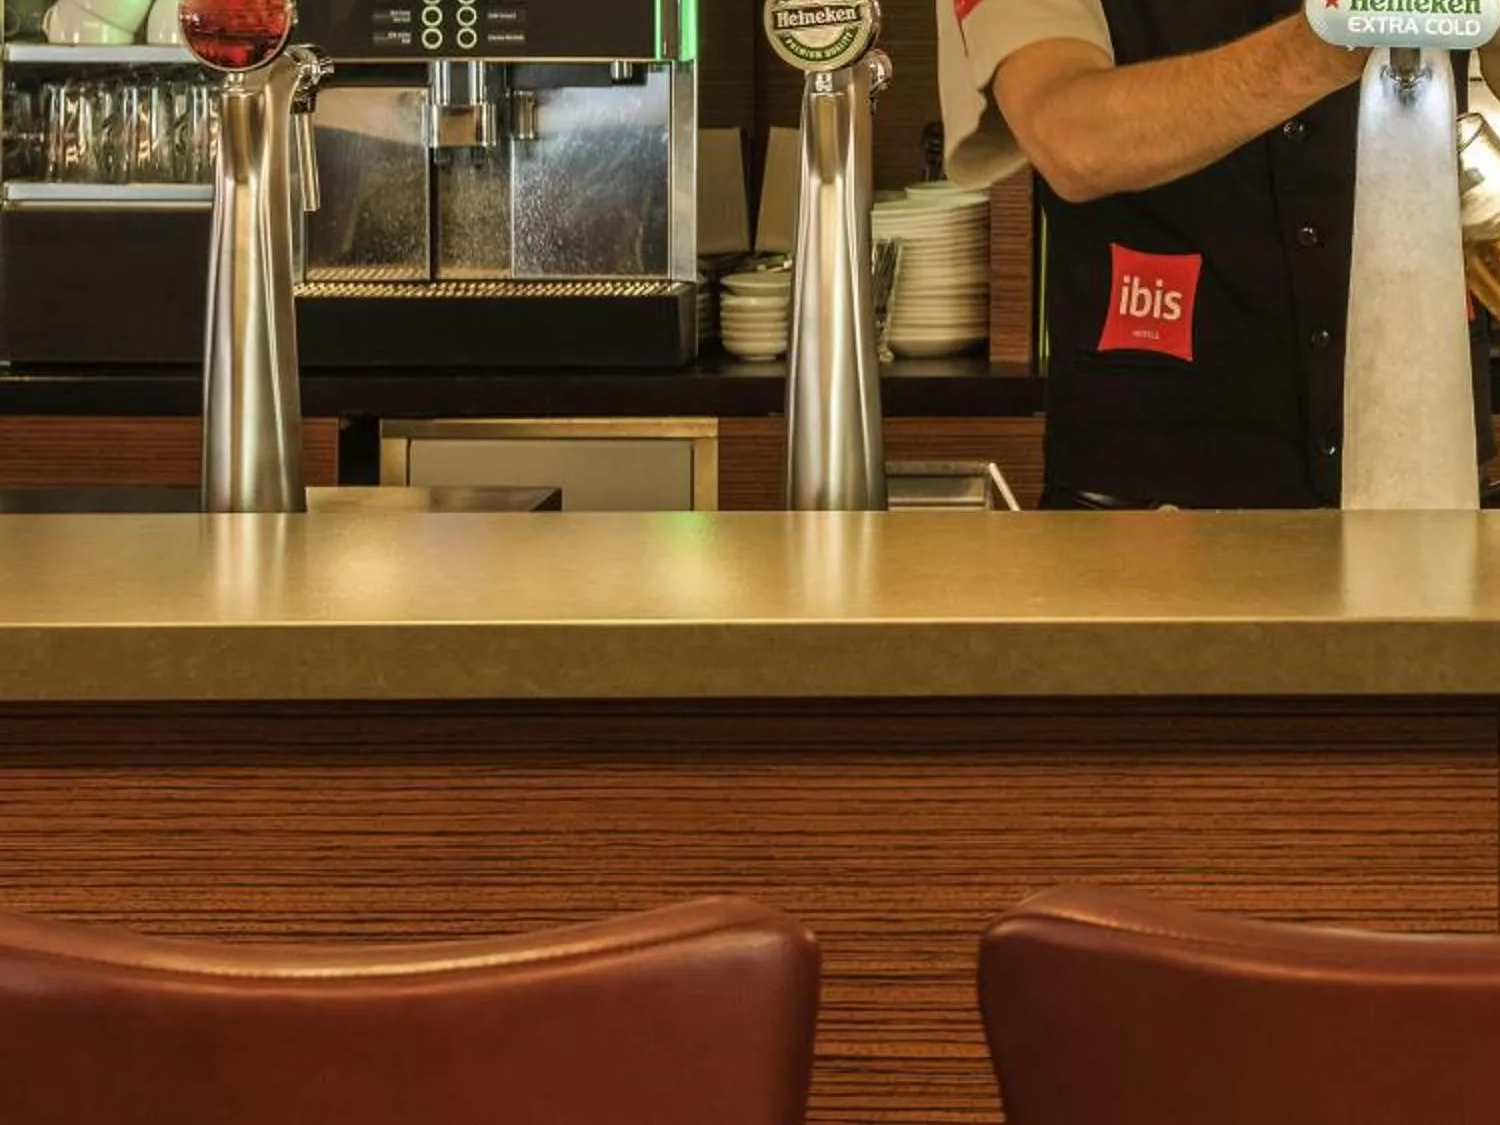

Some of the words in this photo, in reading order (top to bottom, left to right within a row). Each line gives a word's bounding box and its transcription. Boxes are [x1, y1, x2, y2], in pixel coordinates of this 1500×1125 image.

[776, 6, 858, 28] Heineken
[1348, 16, 1421, 35] EXTRA
[1426, 18, 1481, 36] COLD
[1119, 275, 1182, 320] ibis
